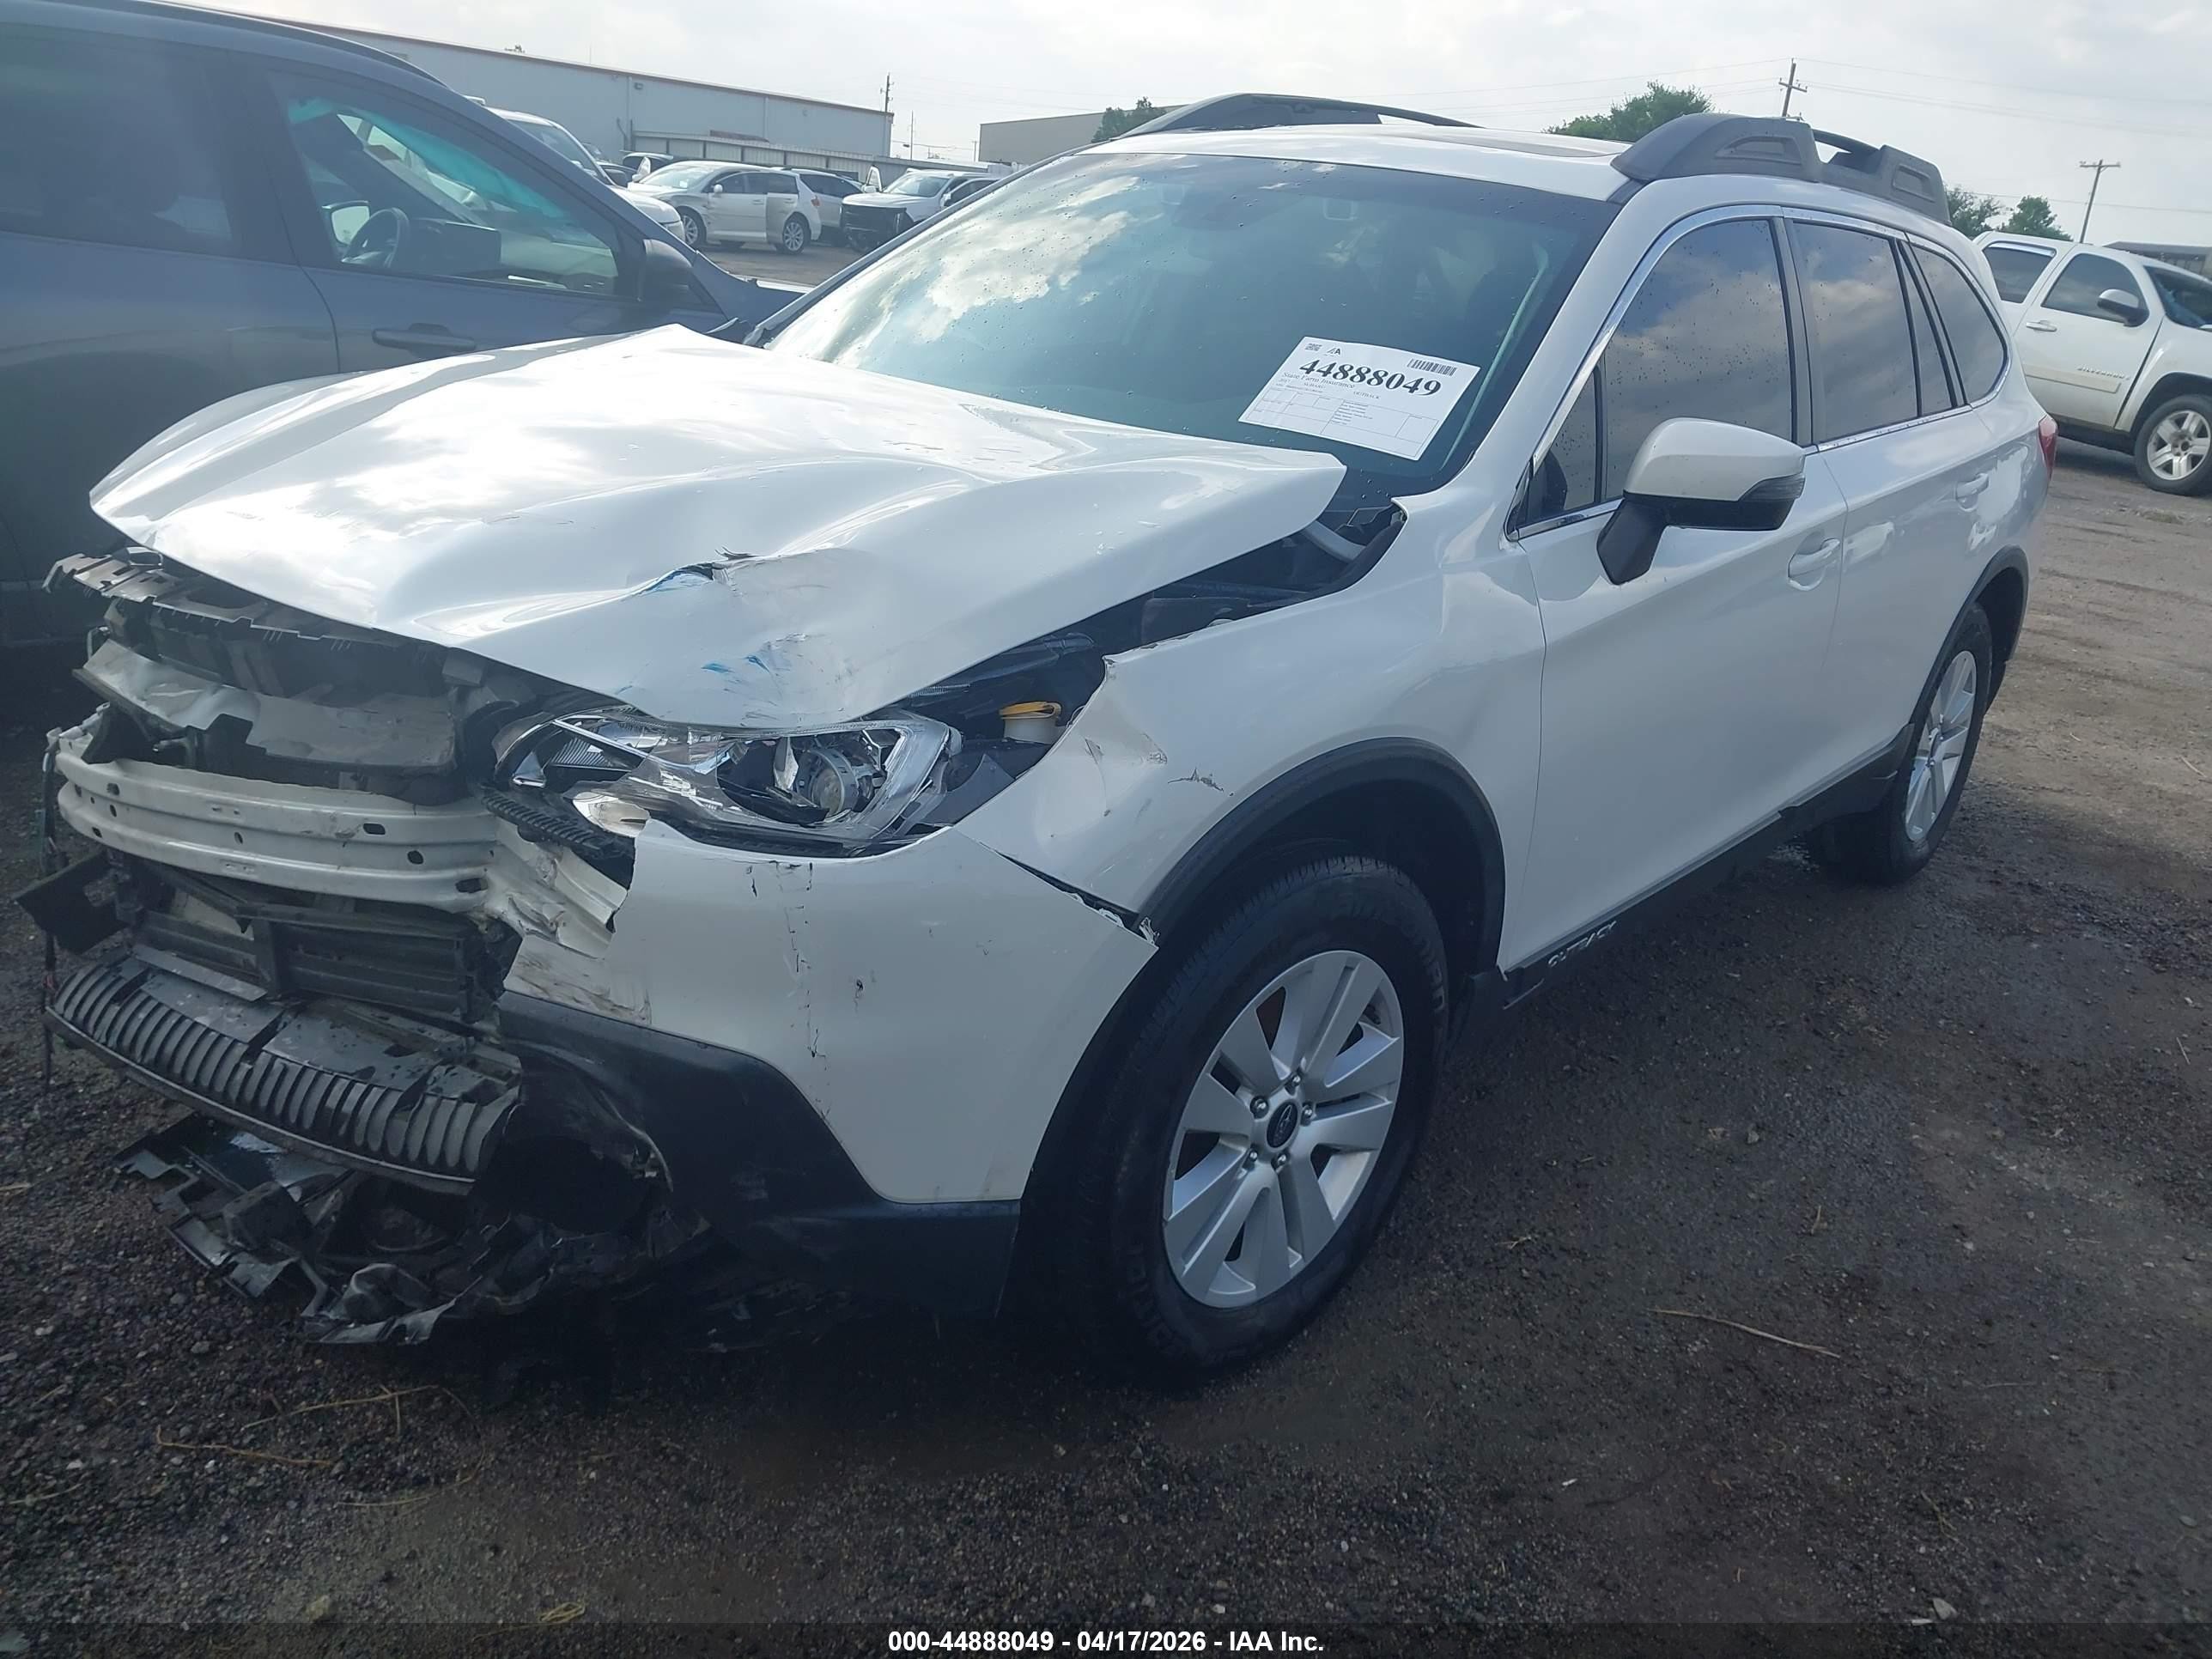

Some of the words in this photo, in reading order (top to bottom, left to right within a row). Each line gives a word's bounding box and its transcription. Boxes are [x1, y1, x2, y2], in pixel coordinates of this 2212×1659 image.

[1298, 359, 1441, 396] 44888049
[1301, 374, 1320, 383] Farm
[1320, 379, 1355, 389] Insurance
